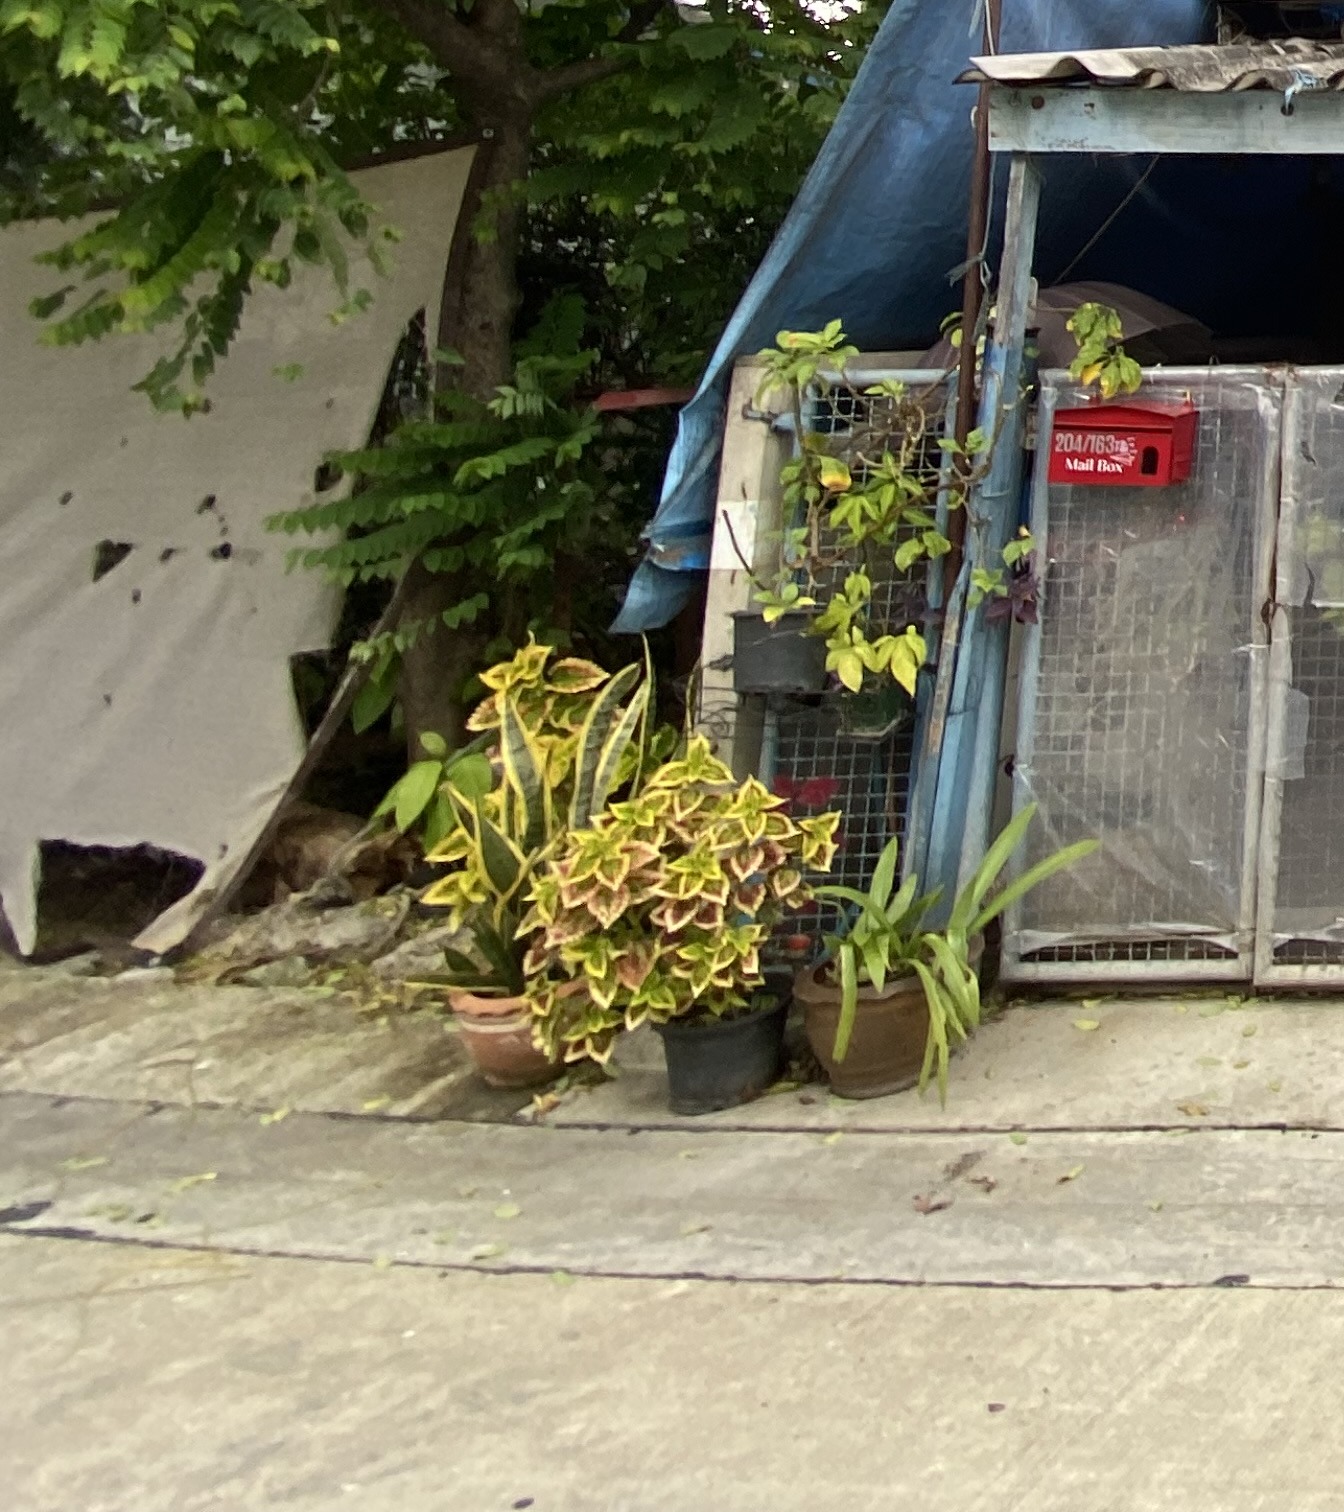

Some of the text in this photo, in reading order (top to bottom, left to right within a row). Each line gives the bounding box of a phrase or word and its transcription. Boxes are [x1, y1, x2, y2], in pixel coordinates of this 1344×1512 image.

[1055, 433, 1115, 454] 204/163
[1066, 458, 1123, 473] Mail Box
